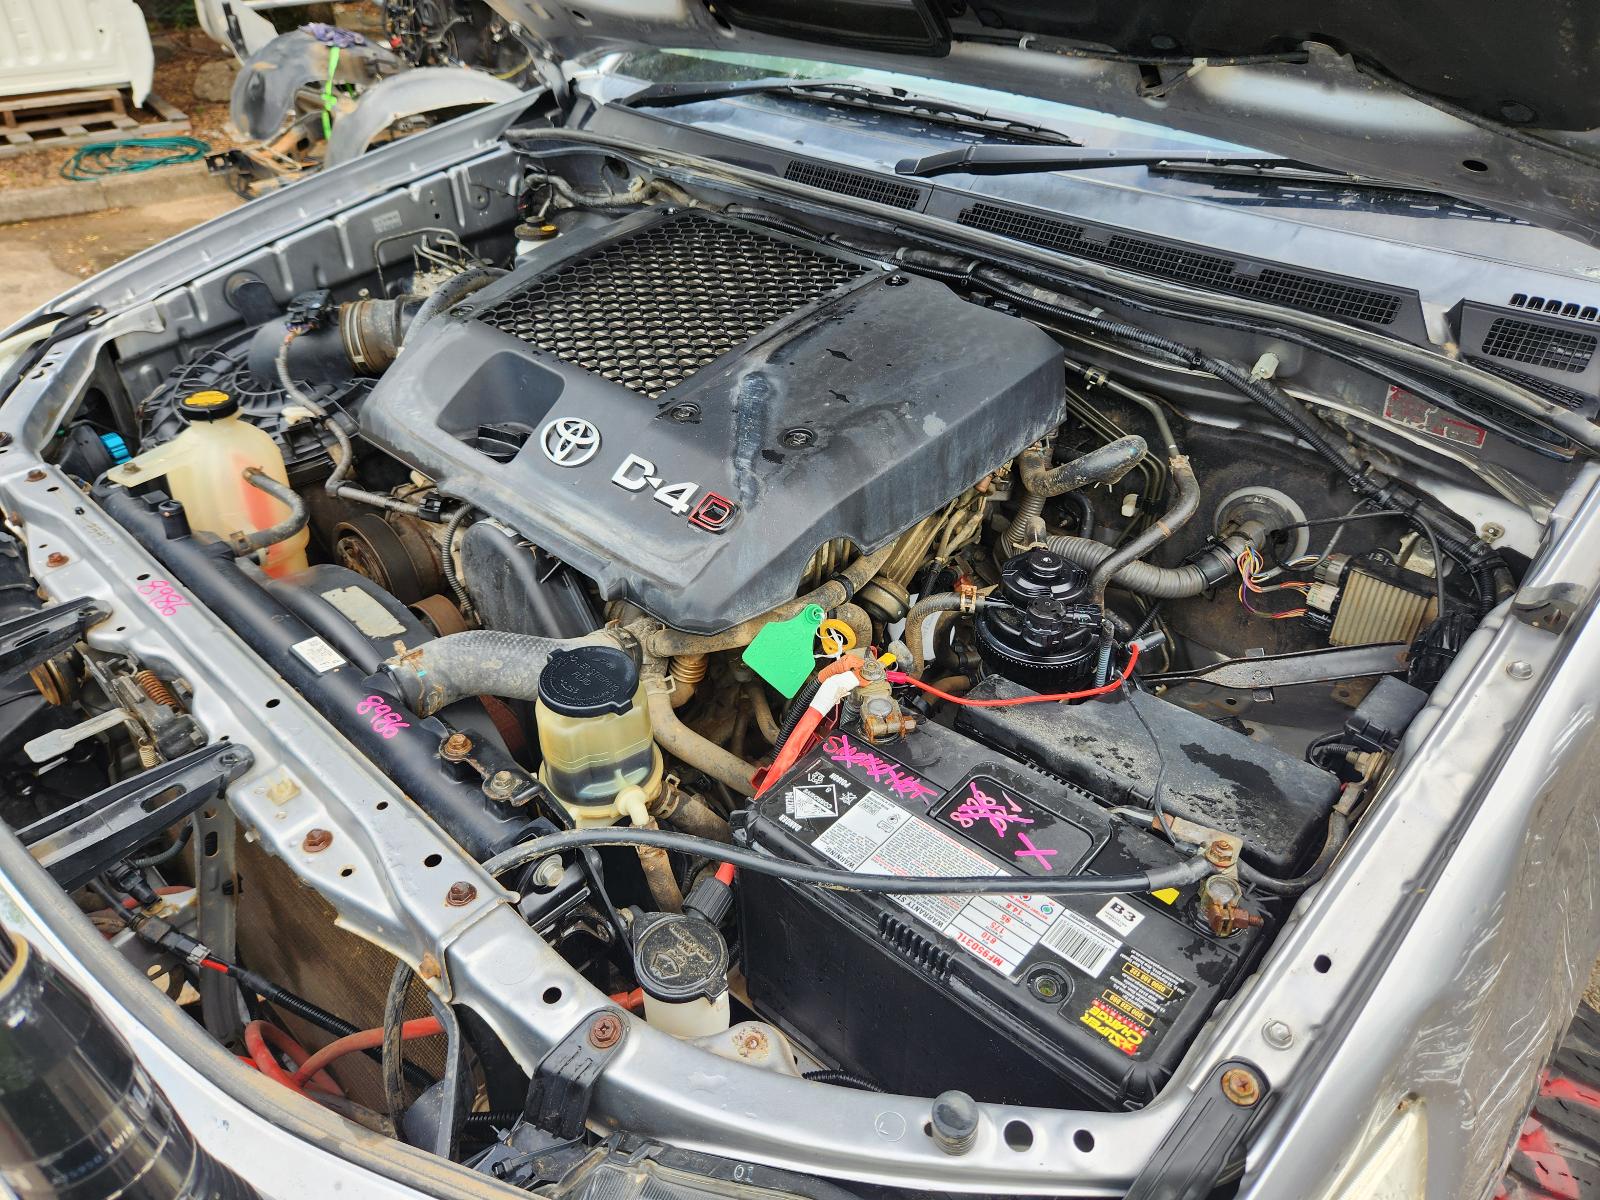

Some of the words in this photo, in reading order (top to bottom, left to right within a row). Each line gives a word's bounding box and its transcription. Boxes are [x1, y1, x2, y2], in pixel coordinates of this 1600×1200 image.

[611, 452, 739, 534] D-4D
[829, 771, 851, 788] POISON
[778, 813, 802, 831] DANGER
[906, 900, 944, 928] WARRANTY
[999, 914, 1011, 923] 95
[1109, 901, 1137, 922] B3
[989, 921, 1004, 933] 175
[955, 931, 1003, 966] MF95D31L
[1078, 1012, 1123, 1047] SUPER
[1084, 1003, 1145, 1046] CHARGE
